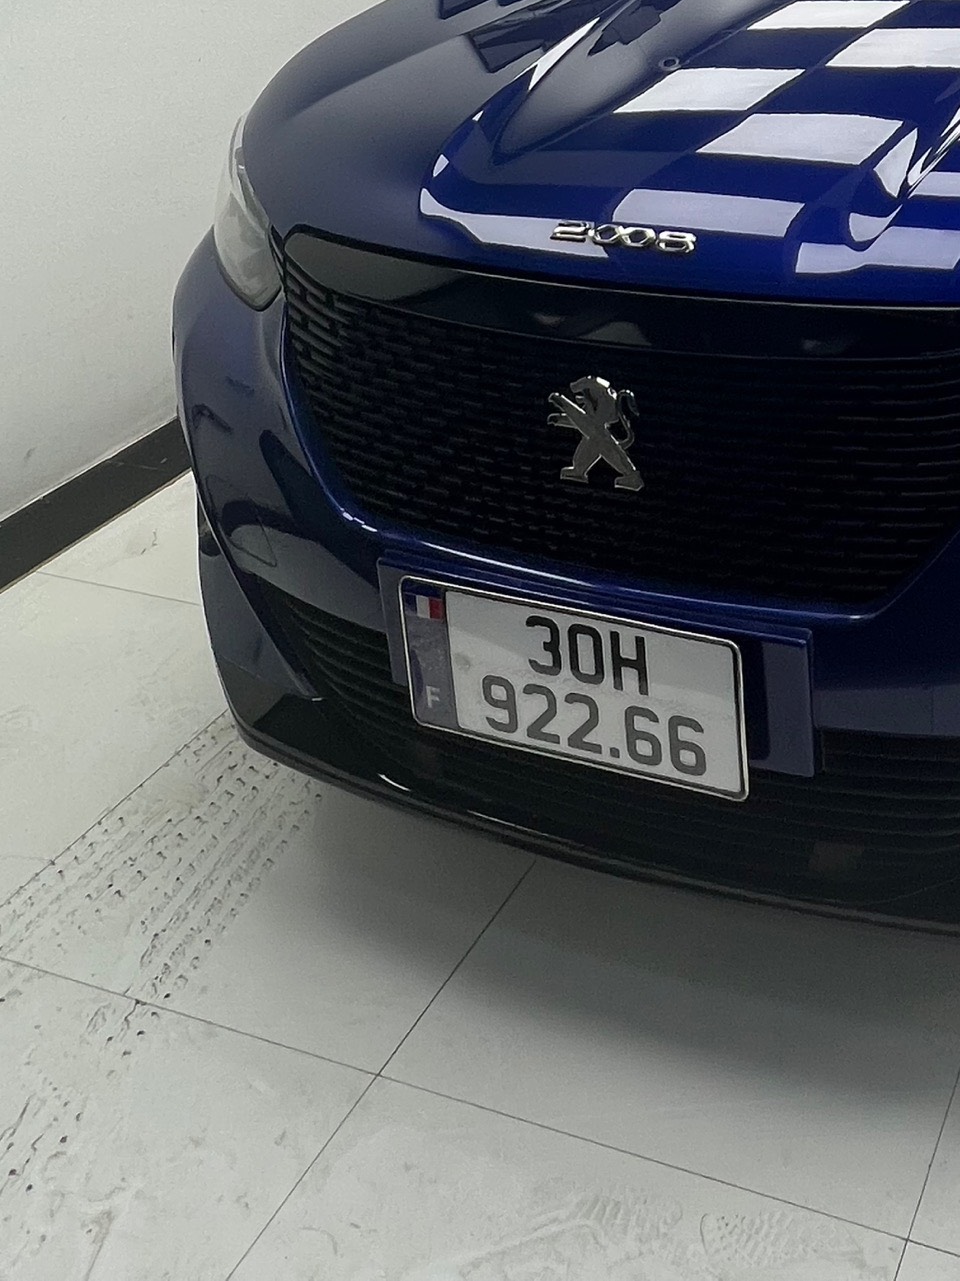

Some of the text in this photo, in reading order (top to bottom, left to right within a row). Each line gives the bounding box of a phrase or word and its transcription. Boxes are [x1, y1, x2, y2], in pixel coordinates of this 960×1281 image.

[550, 219, 698, 255] 2008
[525, 615, 650, 696] 30H
[426, 684, 441, 709] F
[482, 674, 707, 777] 922.66
